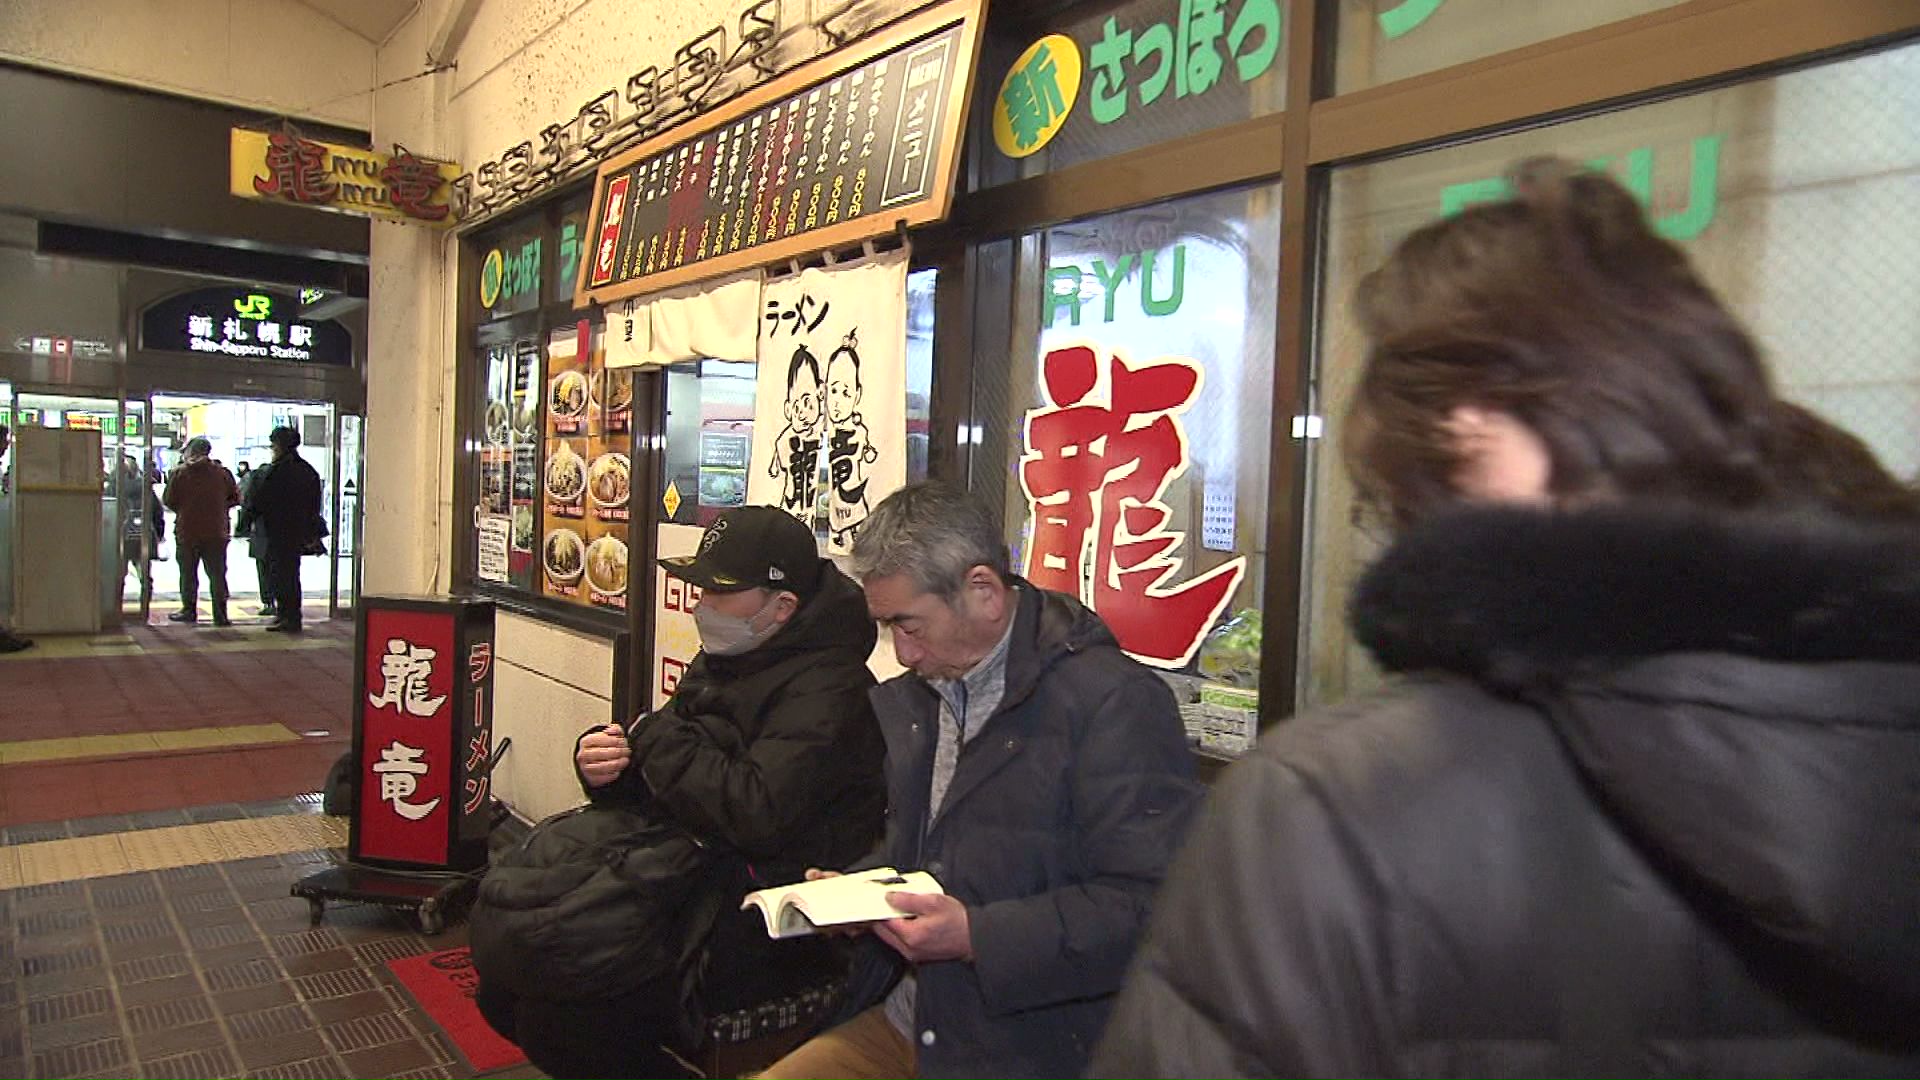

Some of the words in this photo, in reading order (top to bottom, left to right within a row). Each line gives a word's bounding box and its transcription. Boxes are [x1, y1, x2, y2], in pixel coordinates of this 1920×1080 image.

[1001, 43, 1066, 150] 新
[902, 90, 928, 184] メニュー
[332, 154, 376, 178] RYU
[343, 182, 387, 203] RYU
[234, 295, 270, 313] JR
[1044, 243, 1186, 328] RYU
[188, 315, 312, 346] 新札幌駅
[767, 294, 829, 337] ラーメン
[270, 346, 310, 360] Station
[1022, 344, 1244, 662] 龍
[464, 642, 493, 816] ラーメン
